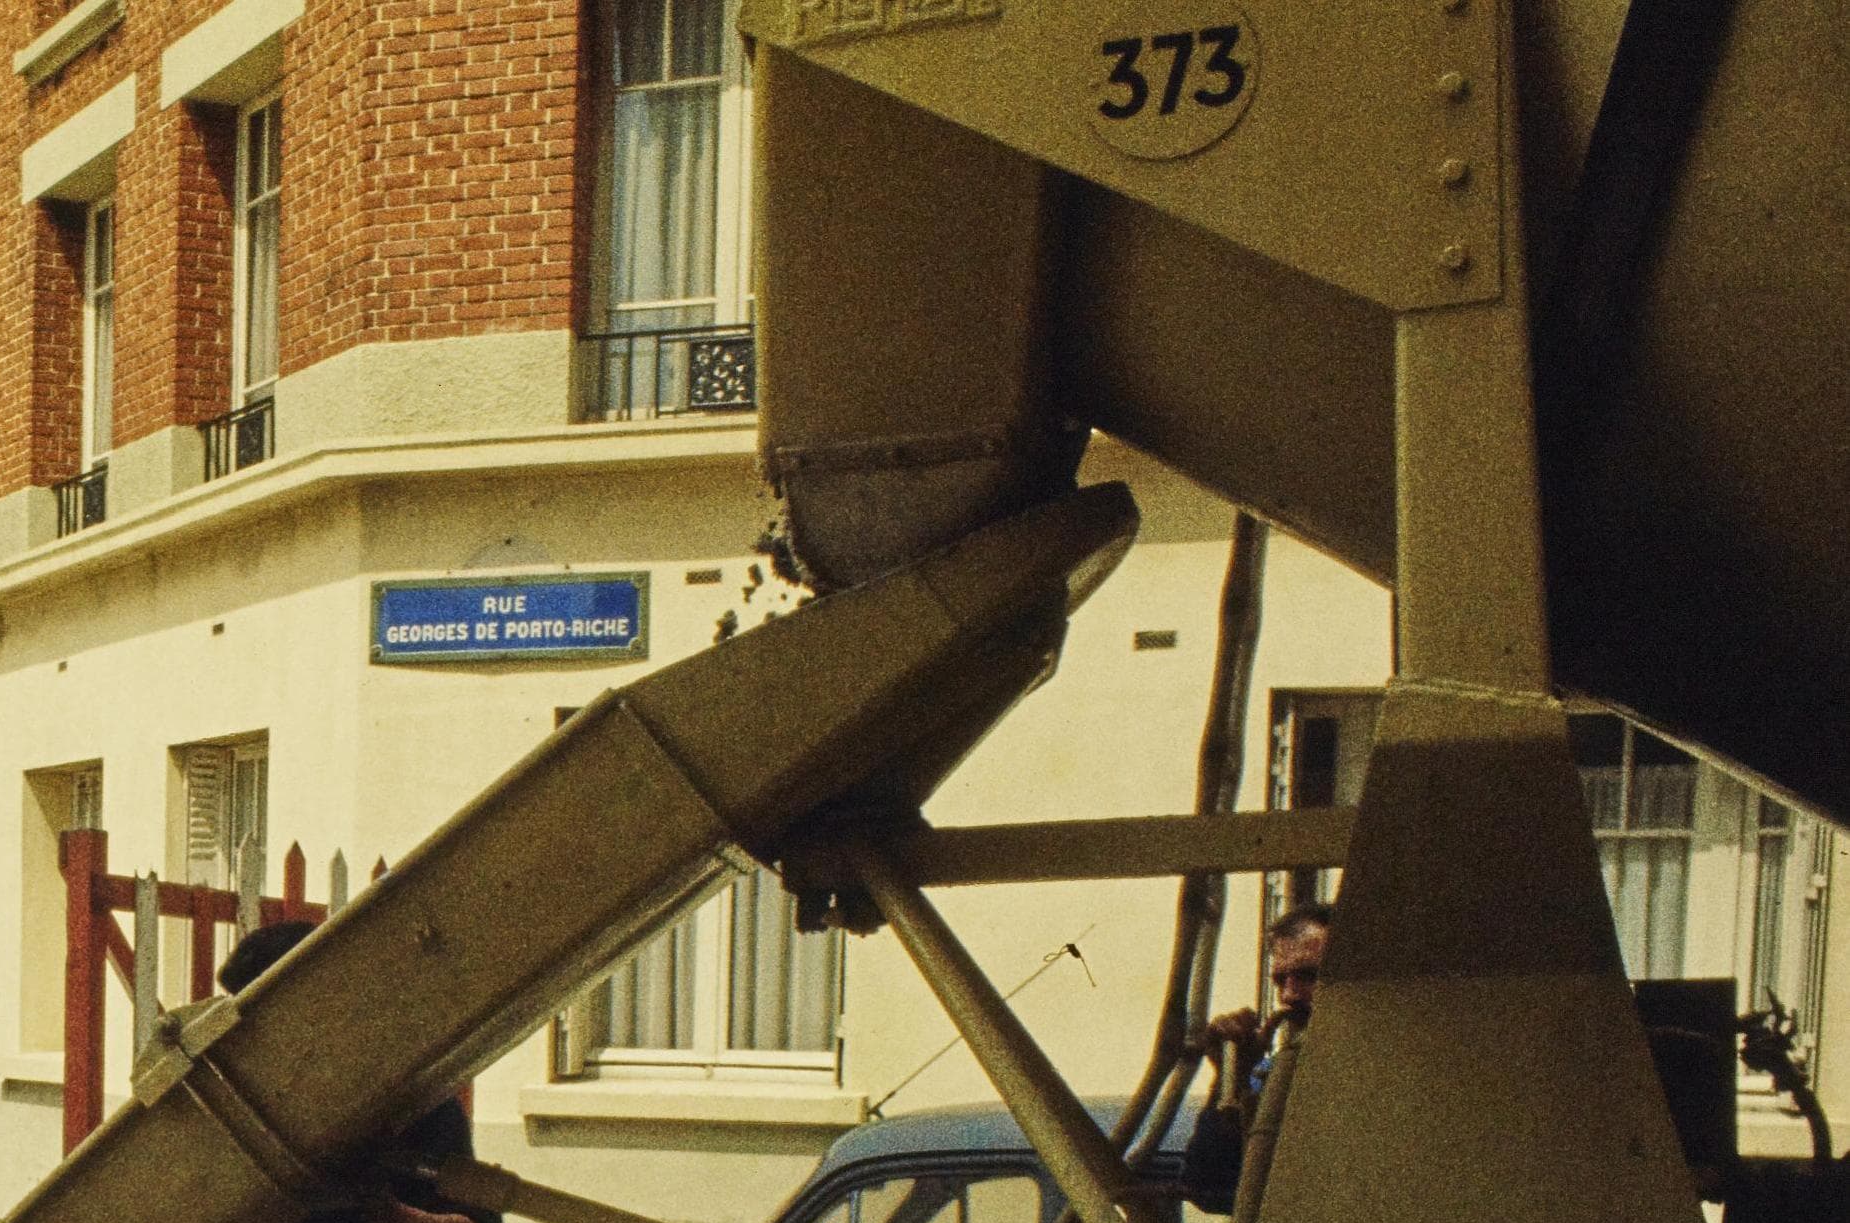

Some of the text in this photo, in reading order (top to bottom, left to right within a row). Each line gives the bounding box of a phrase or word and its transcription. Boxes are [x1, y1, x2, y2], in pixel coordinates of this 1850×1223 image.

[1099, 24, 1250, 120] 373
[482, 595, 527, 615] RUE
[386, 617, 629, 644] GEORGES DE PORTO-RICHE
